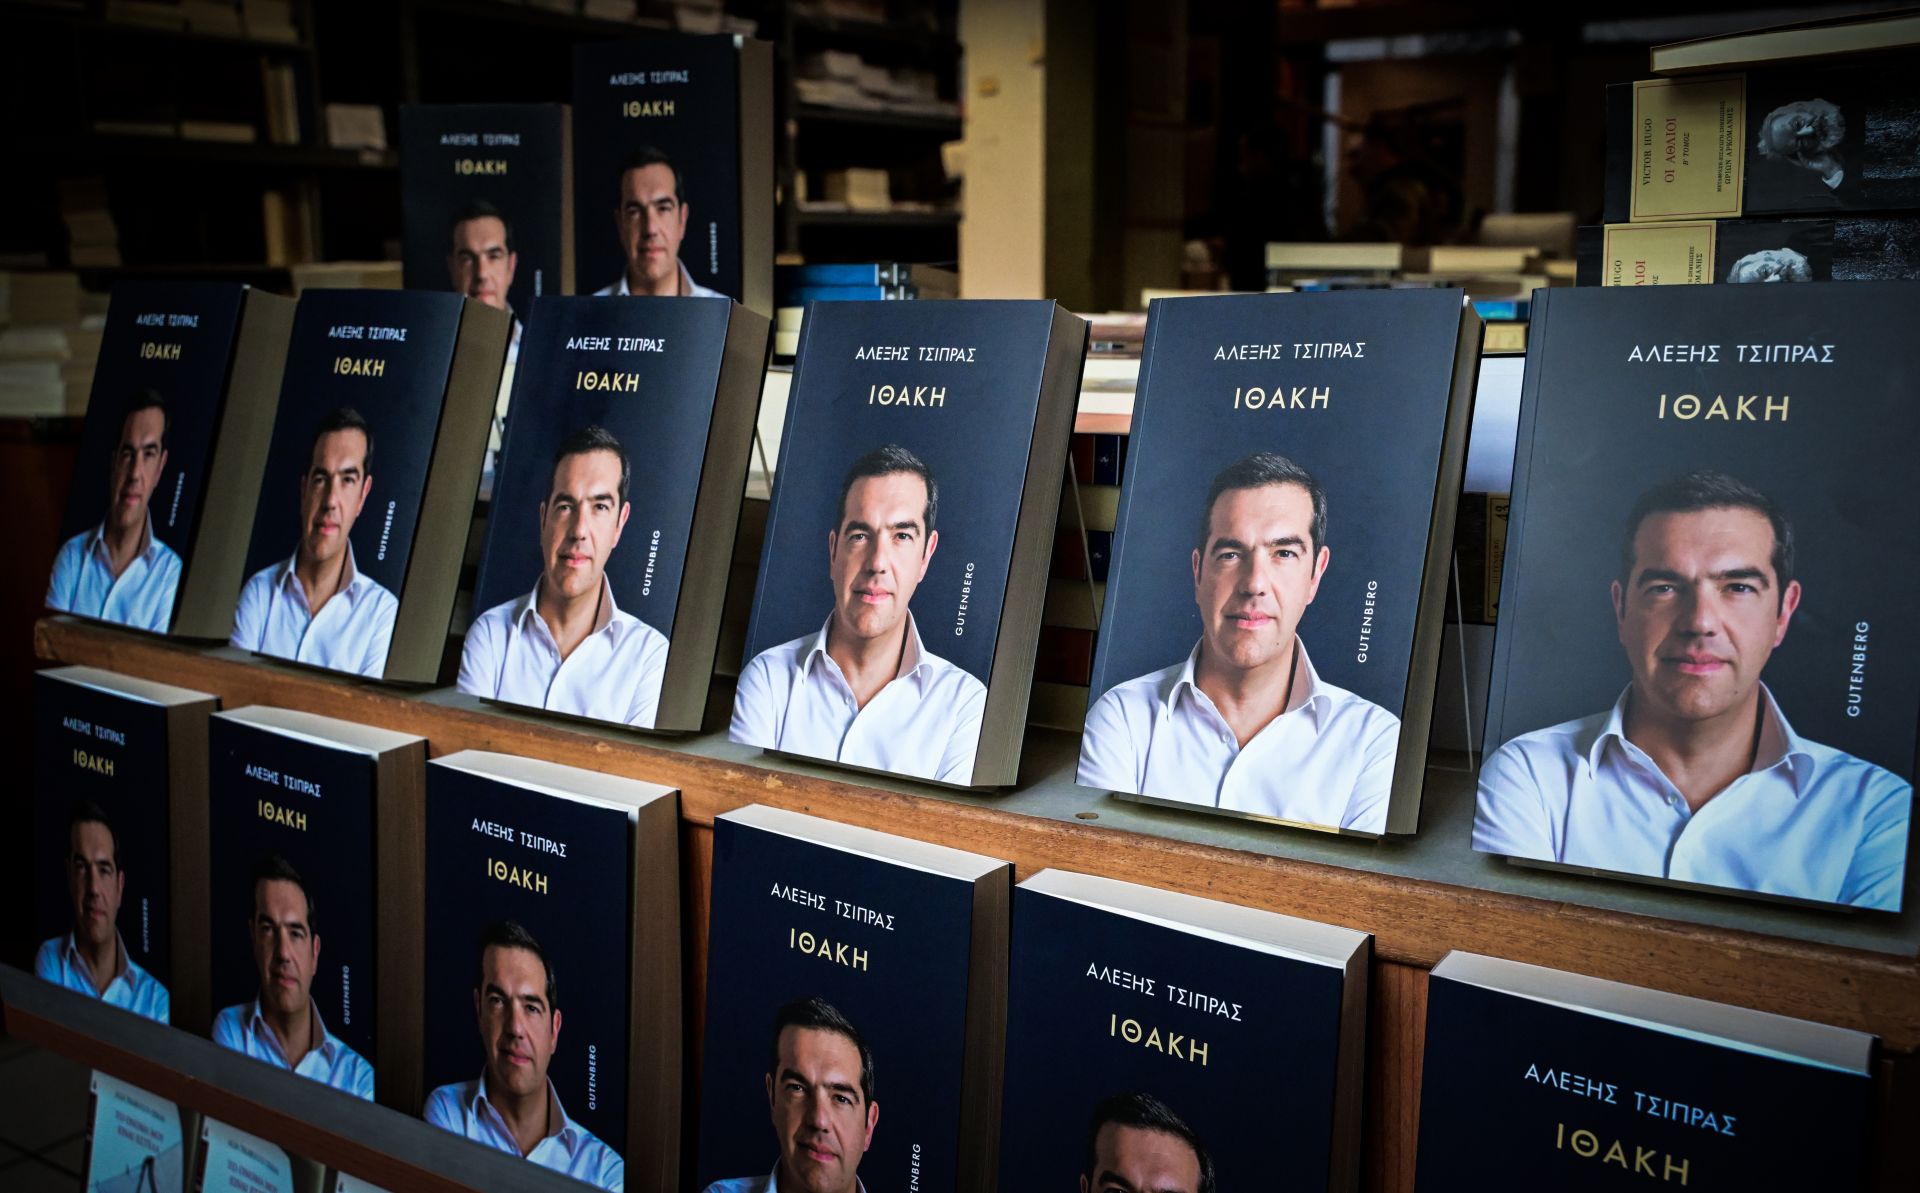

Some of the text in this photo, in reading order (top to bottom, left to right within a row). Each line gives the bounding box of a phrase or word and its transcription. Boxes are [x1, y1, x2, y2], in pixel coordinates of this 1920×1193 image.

[624, 102, 673, 116] ΙΘΑΚΗ
[1643, 118, 1653, 186] VICTOR HUGO
[1665, 118, 1677, 183] ΟΙ ΑΘΛΙΟΙ
[455, 159, 507, 174] ΙΘΑΚΗ
[1635, 260, 1646, 286] ΛΙΟΙ
[137, 314, 199, 327] ΑΛΕΞΗΣ ΤΣΙΠΡΑΣ
[329, 326, 407, 341] ΑΛΕΞΗΣ ΤΣΙΠΡΑΣ
[141, 343, 182, 359] ΙΘΑΚΗ
[566, 337, 665, 352] ΑΛΕΞΗΣ ΤΣΙΠΡΑΣ
[856, 347, 976, 362] ΑΛΕΞΗΣ ΤΣΙΠΡΑΣ
[1214, 343, 1365, 360] ΑΛΕΞΗΣ ΤΣΙΠΡΑΣ
[1628, 345, 1834, 362] ΑΛΕΞΗΣ ΤΣΙΠΡΑΣ
[335, 357, 386, 376] ΙΘΑΚΗ
[575, 371, 640, 392] ΙΘΑΚΗ
[870, 385, 944, 406] ΙΘΑΚΗ
[1235, 387, 1328, 409] ΙΘΑΚΗ
[1660, 395, 1789, 420] ΙΘΑΚΗ
[378, 501, 395, 560] GUTENBERG
[643, 530, 660, 595] GUTENBERG
[956, 563, 974, 635] GUTENBERG
[1358, 581, 1377, 663] GUTENBERG
[1847, 622, 1869, 716] GUTENBERG
[64, 717, 125, 745] ΑΛΕΞΗΣ ΤΣΙΠΡΑΣ
[73, 750, 114, 773] ΙΘΑΚΗ
[246, 765, 320, 797] ΑΛΕΞΗΣ ΤΣΙΠΡΑΣ
[257, 800, 308, 829] ΙΘΑΚΗ
[472, 819, 566, 857] ΑΛΕΞΗΣ ΤΣΙΠΡΑΣ
[486, 858, 549, 895] ΙΘΑΚΗ
[771, 883, 894, 930] ΑΛΕΞΗΣ ΤΣΙΠΡΑΣ
[789, 926, 870, 973] ΙΘΑΚΗ
[1087, 963, 1242, 1021] ΑΛΕΞΗΣ ΤΣΙΠΡΑΣ
[1111, 1015, 1209, 1067] ΙΘΑΚΗ
[1525, 1064, 1735, 1135] ΑΛΕΞΗΣ ΤΣΙΠΡΑΣ
[1557, 1123, 1689, 1184] ΙΘΑΚΗ
[910, 1144, 920, 1193] ENBERG
